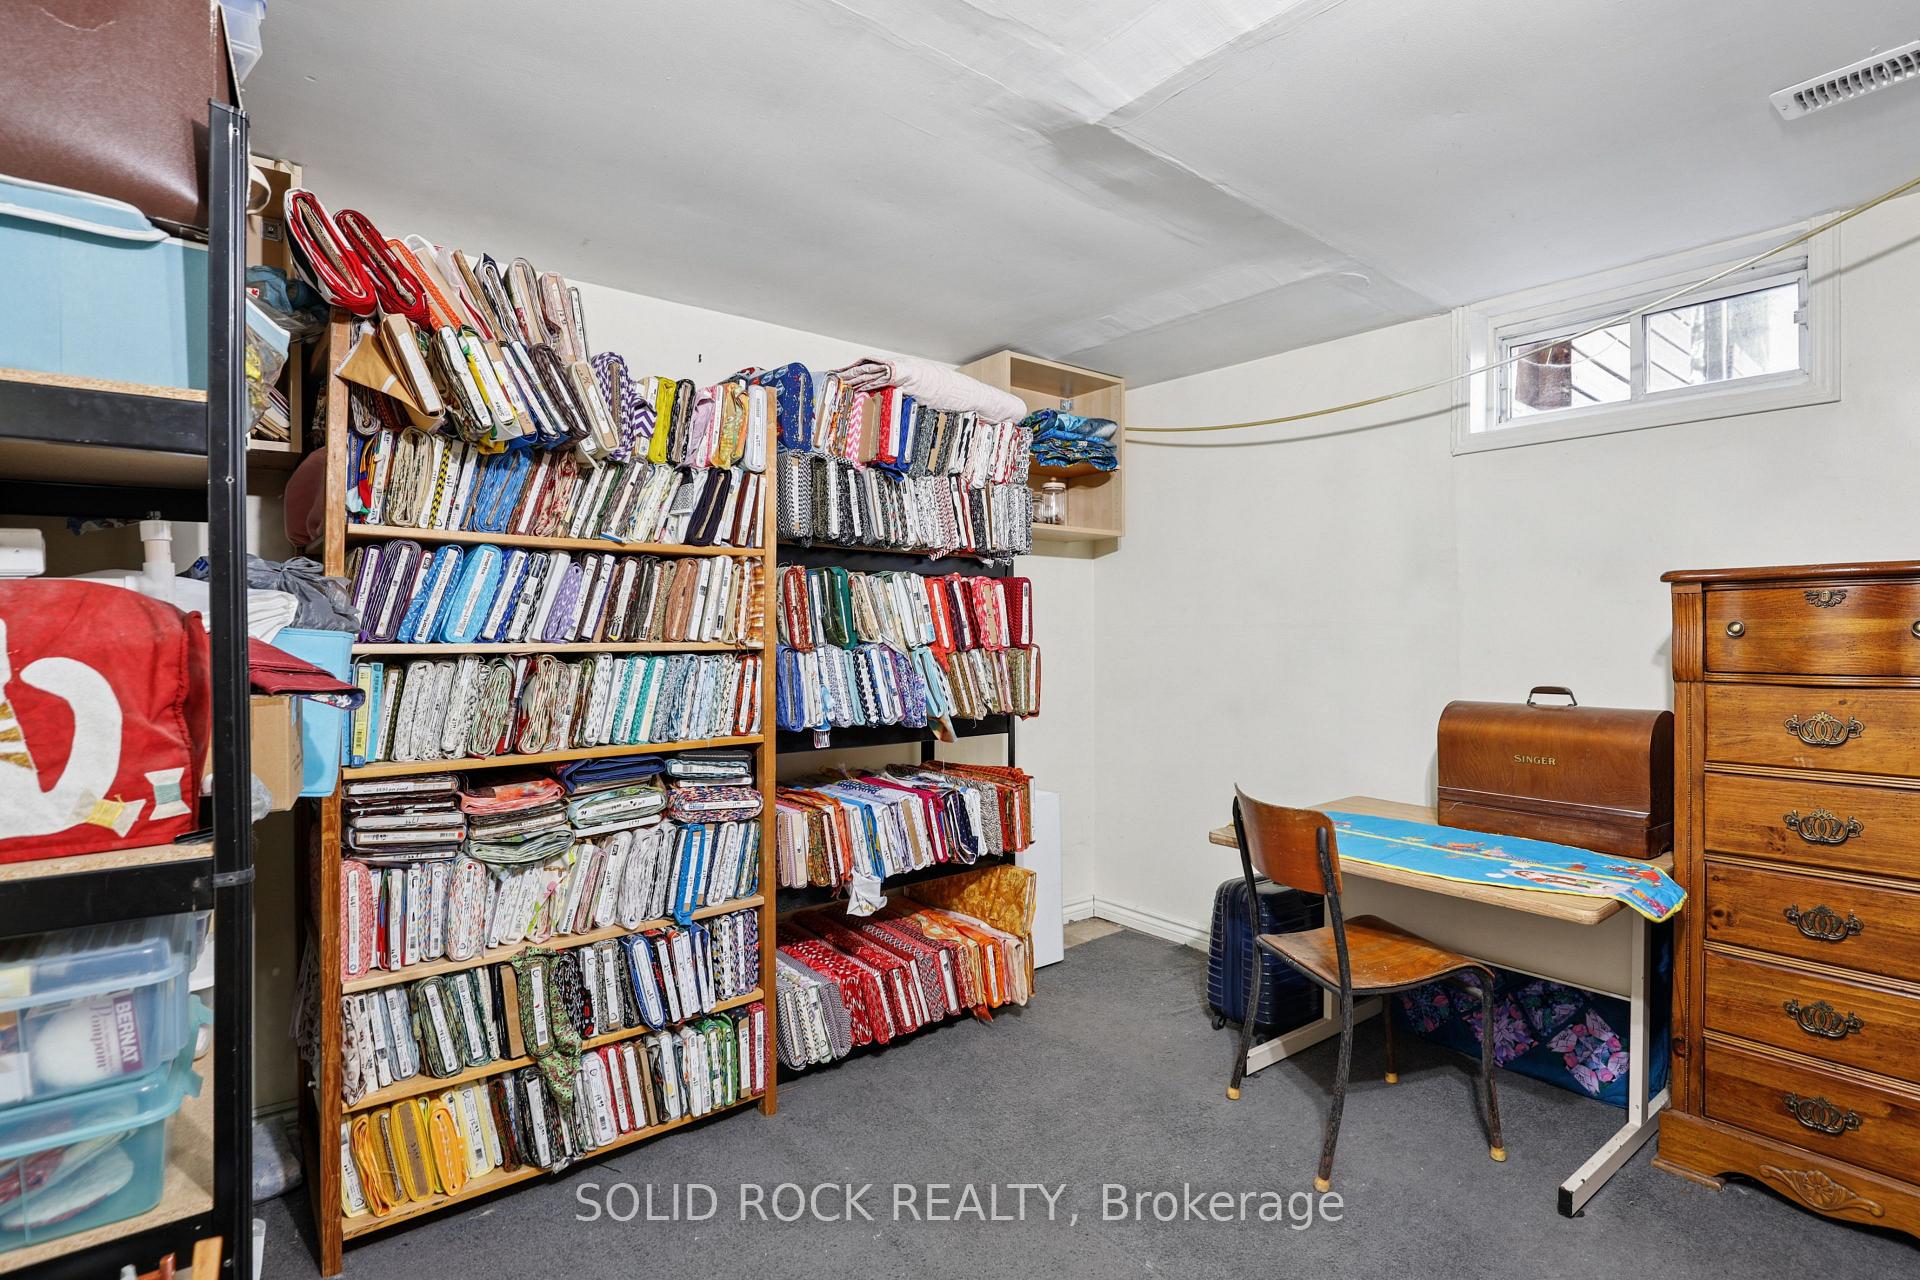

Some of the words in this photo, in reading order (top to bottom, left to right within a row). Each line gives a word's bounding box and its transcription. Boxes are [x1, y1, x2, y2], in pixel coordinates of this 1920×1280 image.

[1513, 754, 1556, 766] SINGER
[563, 908, 573, 933] Benartex
[115, 1002, 139, 1063] BERNAT
